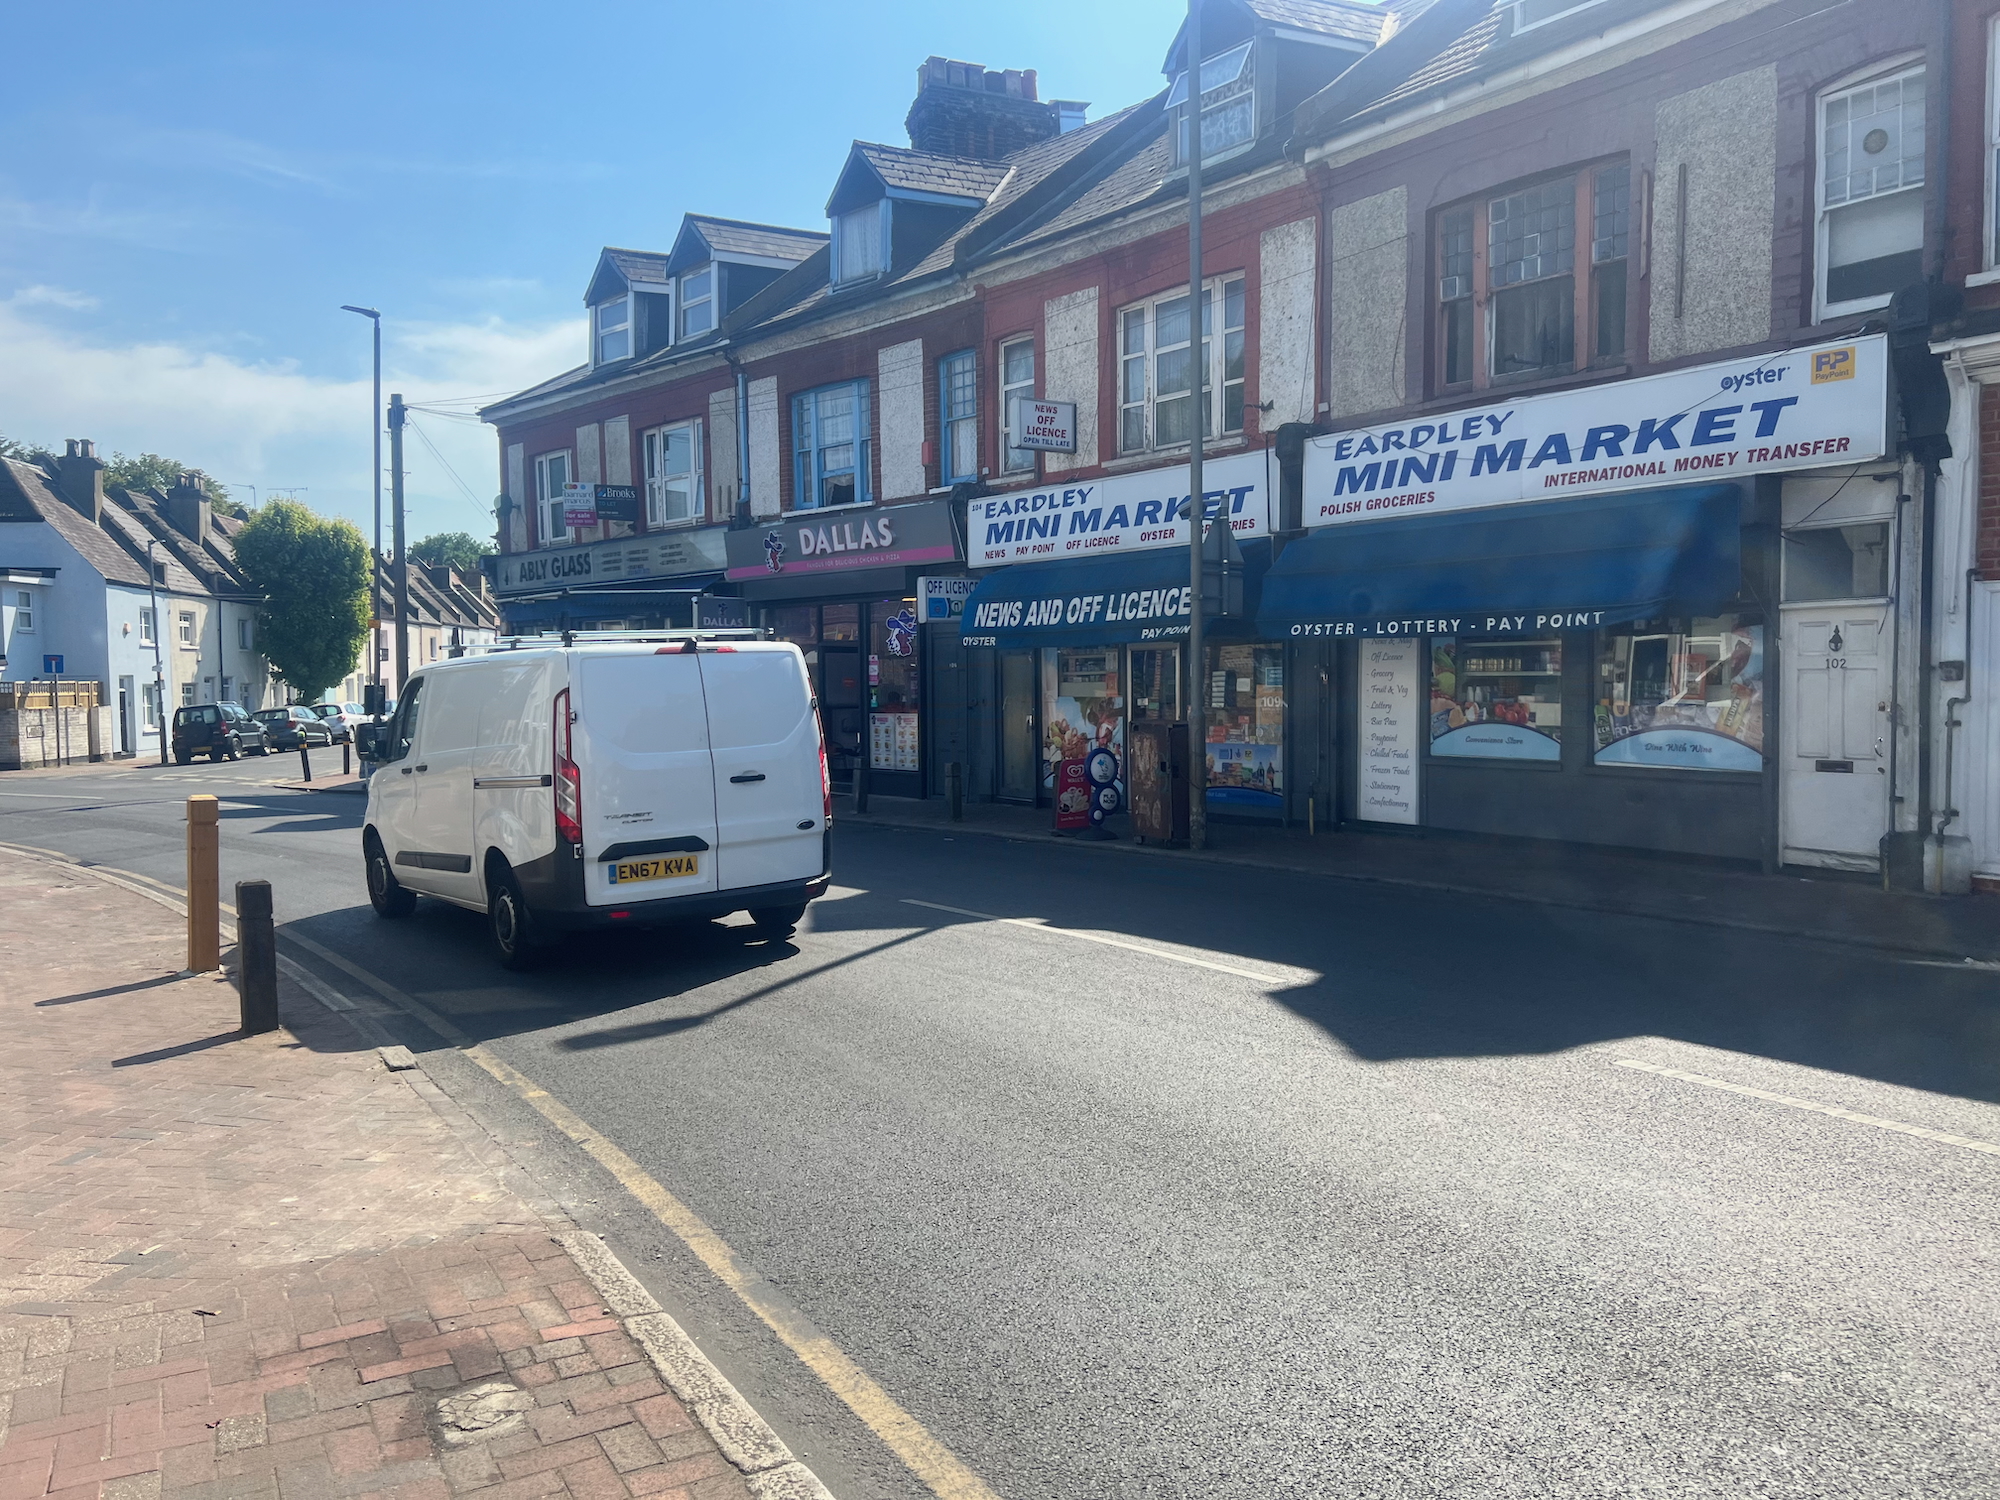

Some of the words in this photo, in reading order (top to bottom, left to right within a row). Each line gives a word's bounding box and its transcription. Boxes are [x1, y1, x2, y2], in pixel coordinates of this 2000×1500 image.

[1720, 367, 1786, 393] oyster
[1815, 368, 1850, 381] PayPoint
[1034, 404, 1058, 414] NEWS
[1037, 415, 1056, 425] OFF
[1026, 425, 1067, 438] LICENCE
[1334, 410, 1514, 461] EARDLEY
[1023, 436, 1040, 444] OPEN
[1041, 438, 1054, 446] TILL
[1333, 449, 1459, 496] MINI
[1470, 396, 1799, 478] MARKET
[1544, 460, 1667, 488] INTERNATIONAL
[1673, 451, 1739, 472] MONEY
[1747, 437, 1851, 463] TRANSFER
[607, 487, 636, 498] Brooks
[972, 503, 982, 512] 104
[985, 486, 1094, 519] EARDLEY
[1320, 497, 1361, 517] POLISH
[1366, 491, 1436, 511] GROCERIES
[985, 513, 1062, 545] MINI
[799, 517, 893, 556] DALLAS
[985, 549, 1006, 560] NEWS
[1016, 546, 1029, 556] PAY
[1032, 543, 1055, 554] POINT
[1066, 539, 1081, 550] OFF
[1084, 535, 1120, 548] LICENCE
[1140, 528, 1175, 542] OYSTER
[519, 559, 548, 583] ABLY
[551, 552, 592, 578] GLASS
[835, 557, 858, 567] DELICIOUS
[859, 556, 879, 564] CHICKEN
[927, 580, 943, 594] OFF
[974, 600, 1022, 628] NEWS
[1023, 598, 1063, 627] AND
[1066, 594, 1104, 625] OFF
[1105, 586, 1191, 622] LICENCE
[703, 616, 744, 627] DALLAS
[1290, 622, 1355, 637] OYSTER
[1376, 619, 1462, 634] LOTTERY
[1486, 615, 1525, 631] PAY
[1536, 611, 1605, 629] POINT
[1141, 627, 1163, 639] PAY
[962, 636, 996, 647] OYSTER
[1371, 652, 1382, 663] Off
[1382, 652, 1403, 661] Licence
[1826, 658, 1847, 669] 102
[1371, 668, 1394, 681] Grocery
[1371, 684, 1387, 693] Fruit
[1388, 685, 1394, 694] &
[1397, 684, 1408, 698] Veg
[1370, 700, 1392, 714] Lottery
[1371, 716, 1382, 725] Bus
[1384, 716, 1397, 725] Pass
[1371, 732, 1398, 746] Paypoint
[1465, 735, 1503, 744] Convenience
[1505, 736, 1523, 744] Store
[1370, 747, 1392, 758] Chilled
[1391, 748, 1409, 759] Foods
[1645, 742, 1662, 752] Dine
[1665, 742, 1687, 752] With
[1690, 744, 1712, 753] Wine
[1370, 764, 1391, 774] Frozen
[1392, 765, 1410, 775] Foods
[1370, 780, 1400, 795] Stationery
[1369, 796, 1409, 812] Confectionery
[604, 811, 653, 820] TRANSIT
[618, 861, 659, 880] EN67
[664, 858, 694, 875] KVA
